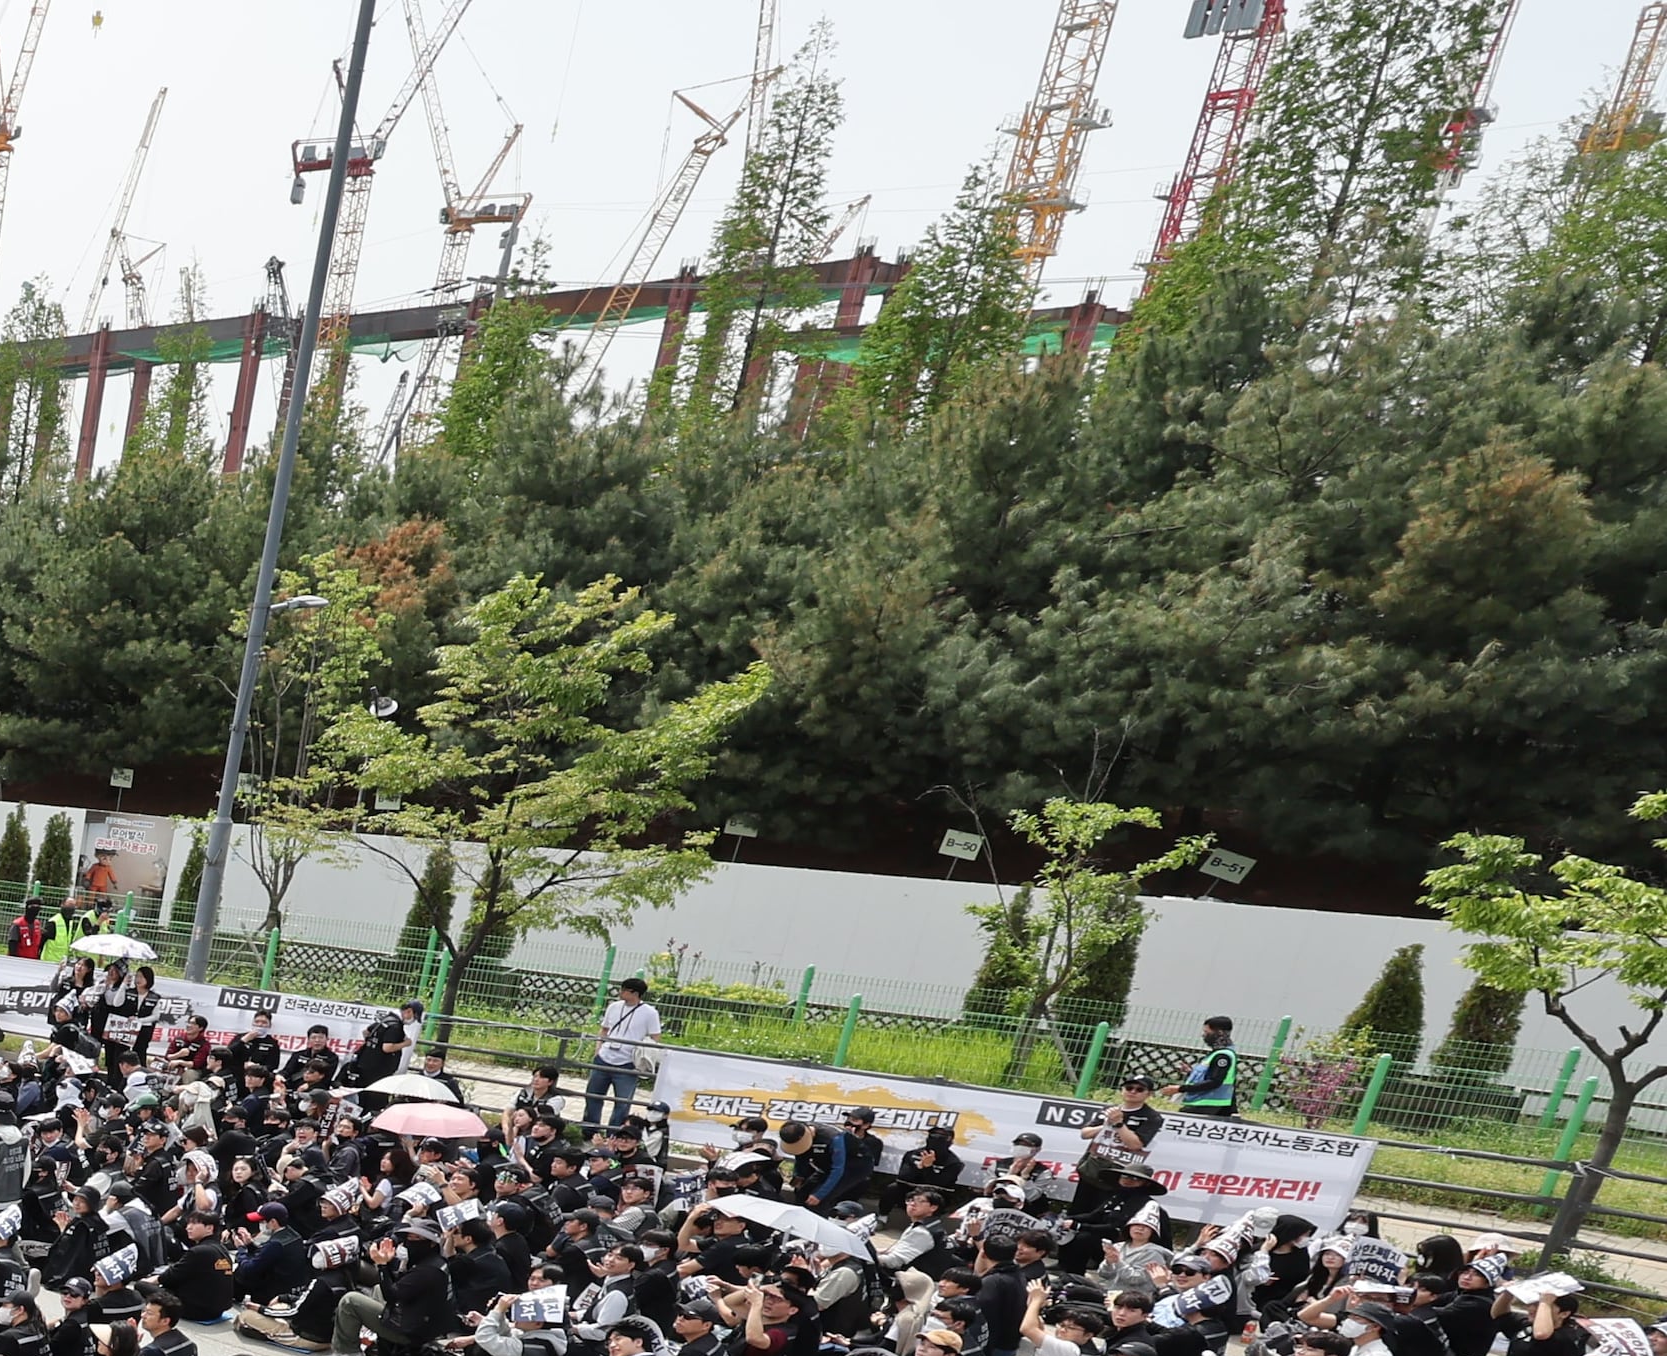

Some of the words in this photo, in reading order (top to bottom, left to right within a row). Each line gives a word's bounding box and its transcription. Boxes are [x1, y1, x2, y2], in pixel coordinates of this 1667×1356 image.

[122, 840, 157, 855] 사용금지
[223, 992, 277, 1011] NSEU
[693, 1093, 764, 1118] 적자는
[1187, 1171, 1323, 1202] 책임져라!
